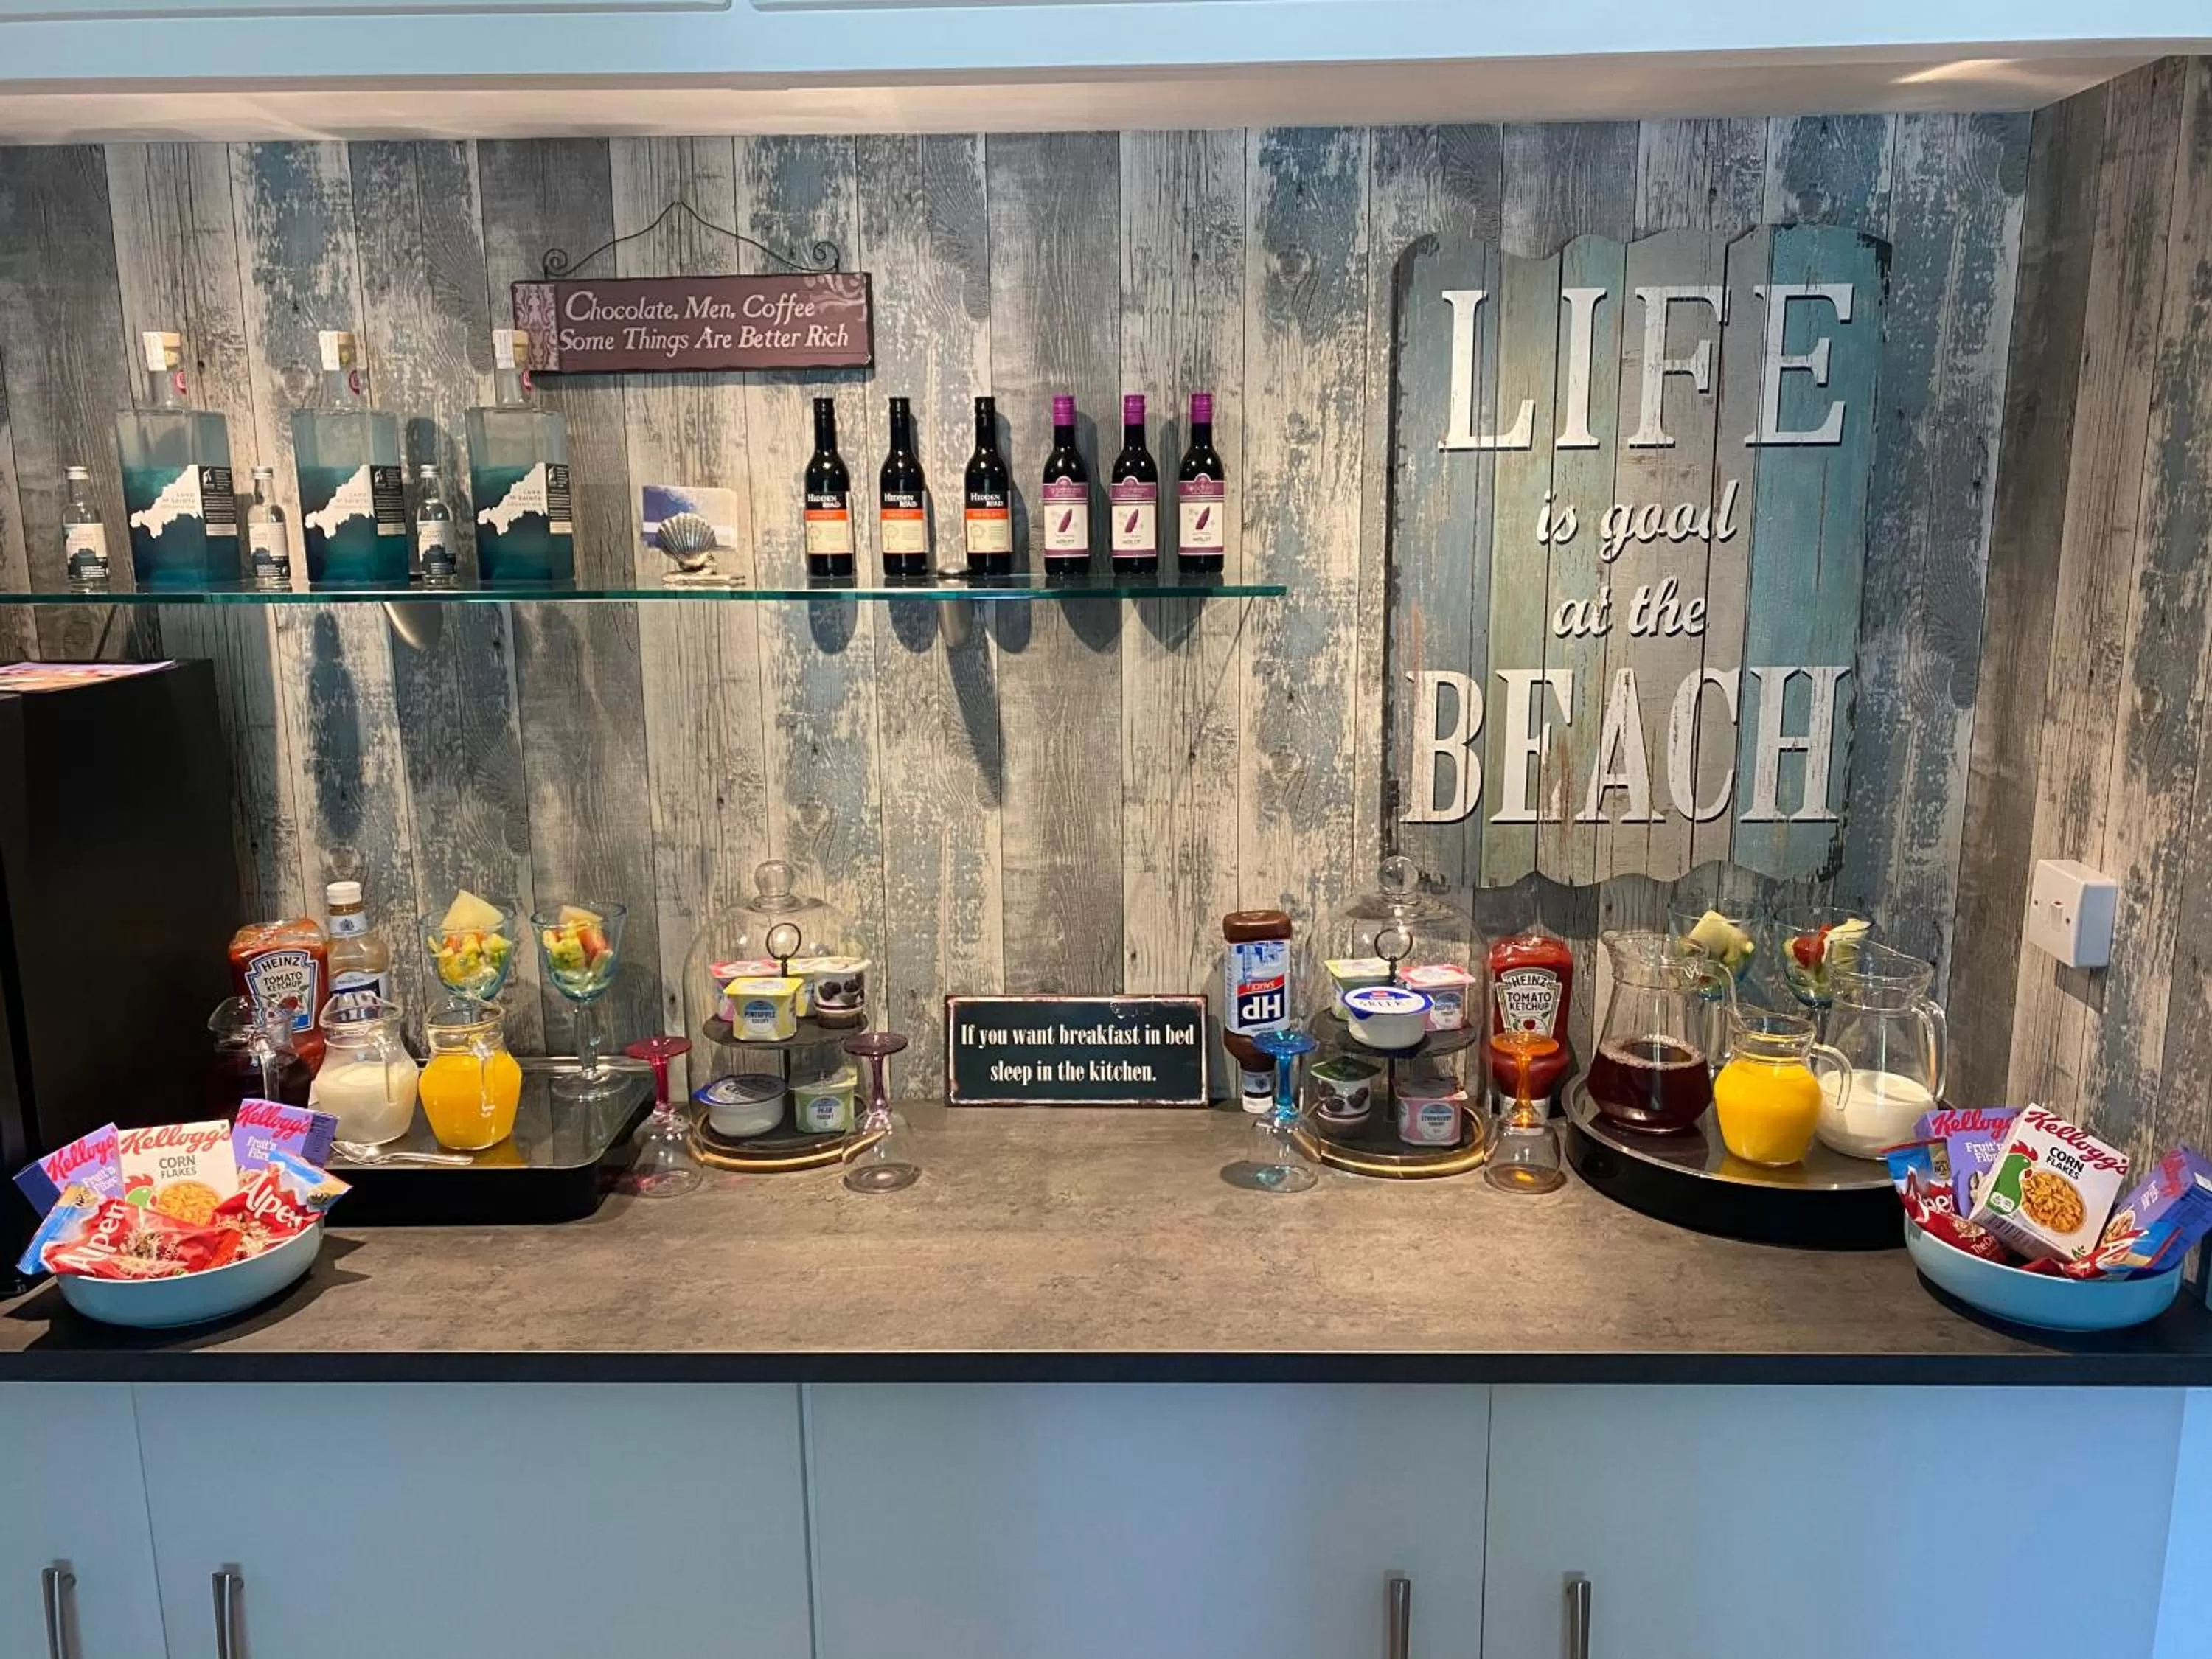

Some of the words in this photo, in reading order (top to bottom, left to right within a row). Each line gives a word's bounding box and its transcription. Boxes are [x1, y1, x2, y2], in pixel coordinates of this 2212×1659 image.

[742, 293, 815, 324] Coffee
[558, 328, 615, 351] Some
[622, 327, 689, 358] Things
[694, 325, 732, 349] Are
[739, 324, 801, 349] Better
[804, 322, 849, 347] Rich
[1439, 283, 1855, 451] LIFE
[1536, 489, 1579, 543] is
[1600, 480, 1739, 561] good
[1551, 588, 1612, 638] at
[1629, 577, 1710, 638] the
[1398, 664, 1854, 825] BEACH
[261, 957, 299, 972] HEINZ
[263, 971, 302, 986] TOMATO
[1512, 975, 1547, 987] HEINZ
[1241, 993, 1281, 1020] HP
[1506, 992, 1552, 1002] TOMATO
[1509, 1002, 1549, 1011] KETCHUP
[961, 1024, 975, 1045] If
[978, 1029, 1008, 1049] you
[1012, 1026, 1055, 1045] want
[1060, 1024, 1141, 1045] breakfast
[1144, 1024, 1161, 1045] in
[1165, 1024, 1194, 1045] bed
[990, 1060, 1032, 1086] sleep
[1037, 1060, 1052, 1082] in
[1057, 1060, 1085, 1082] the
[1089, 1060, 1157, 1082] kitchen.
[120, 1124, 231, 1155] Kellogg's
[2024, 1110, 2129, 1175] Kellogg's
[159, 1155, 196, 1169] CORN
[160, 1167, 197, 1179] FLAKES
[2046, 1155, 2081, 1180] FLAKES
[2050, 1147, 2084, 1173] CORN
[54, 1203, 130, 1271] Alpen
